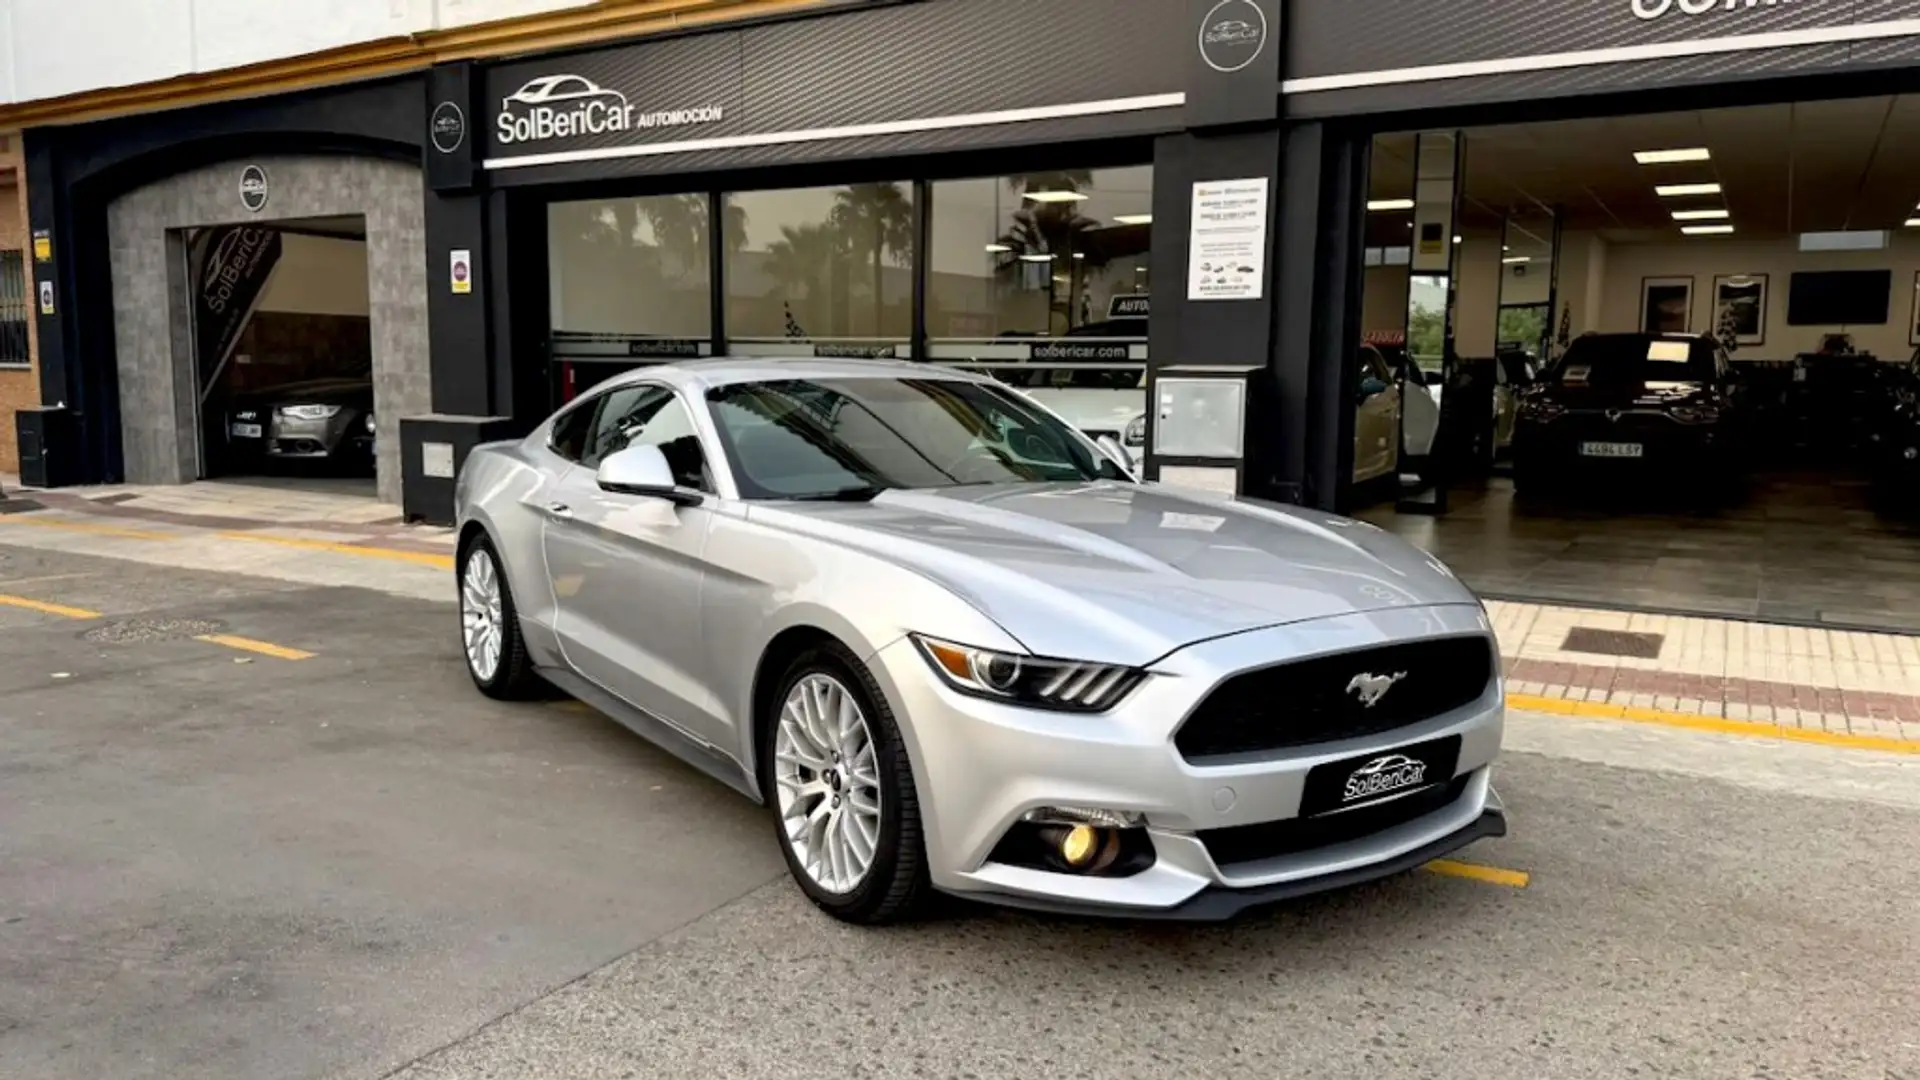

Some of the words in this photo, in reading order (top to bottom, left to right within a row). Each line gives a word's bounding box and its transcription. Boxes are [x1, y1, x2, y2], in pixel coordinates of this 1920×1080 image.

[497, 100, 635, 144] SolBeriCar
[637, 106, 724, 129] AUTOMOCIÓN
[1034, 343, 1126, 358] solbericar.com
